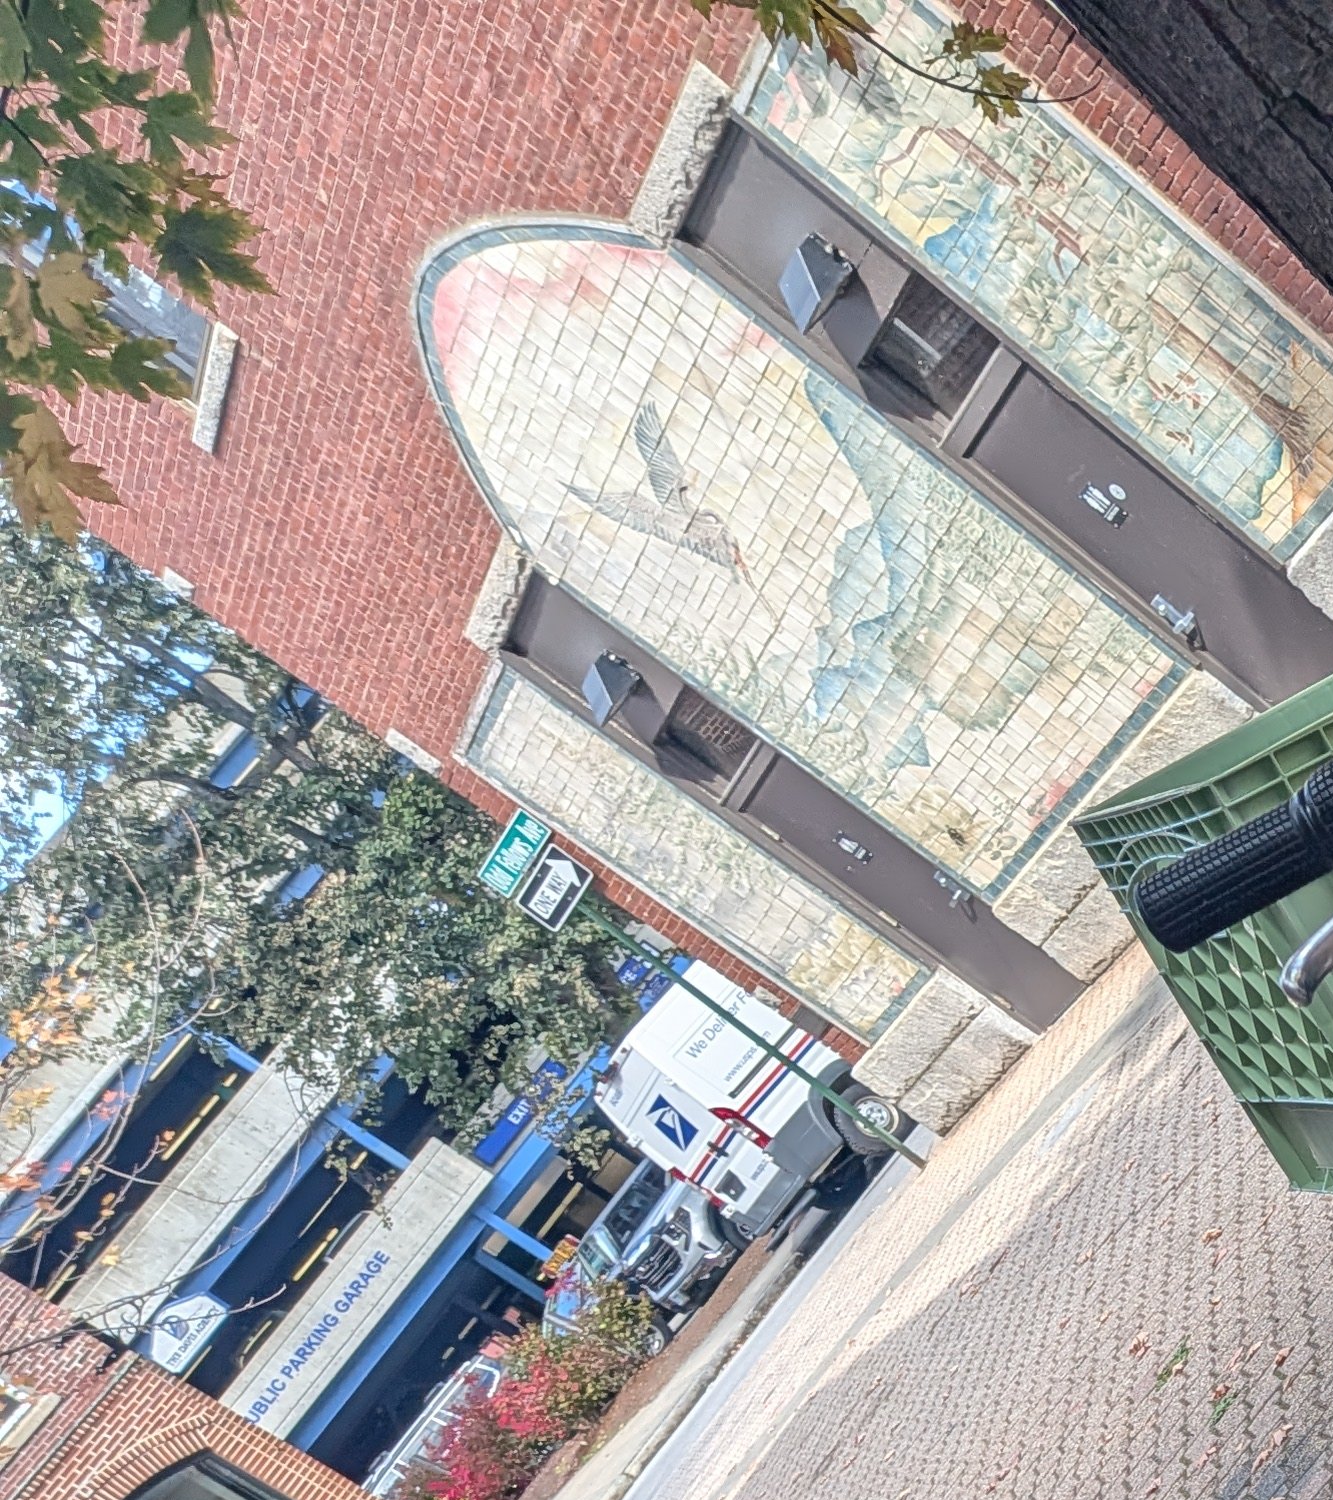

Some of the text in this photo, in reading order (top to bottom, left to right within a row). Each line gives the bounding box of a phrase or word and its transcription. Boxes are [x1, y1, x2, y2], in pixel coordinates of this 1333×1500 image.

[484, 819, 544, 891] Odd Fellows Ave
[533, 871, 568, 915] ONE WAY
[685, 1039, 709, 1059] We
[705, 1003, 745, 1041] Delier
[723, 1030, 772, 1082] www.usps.m
[507, 1099, 531, 1125] EXIT
[247, 1250, 391, 1424] UBLIC PARKING GARAGE
